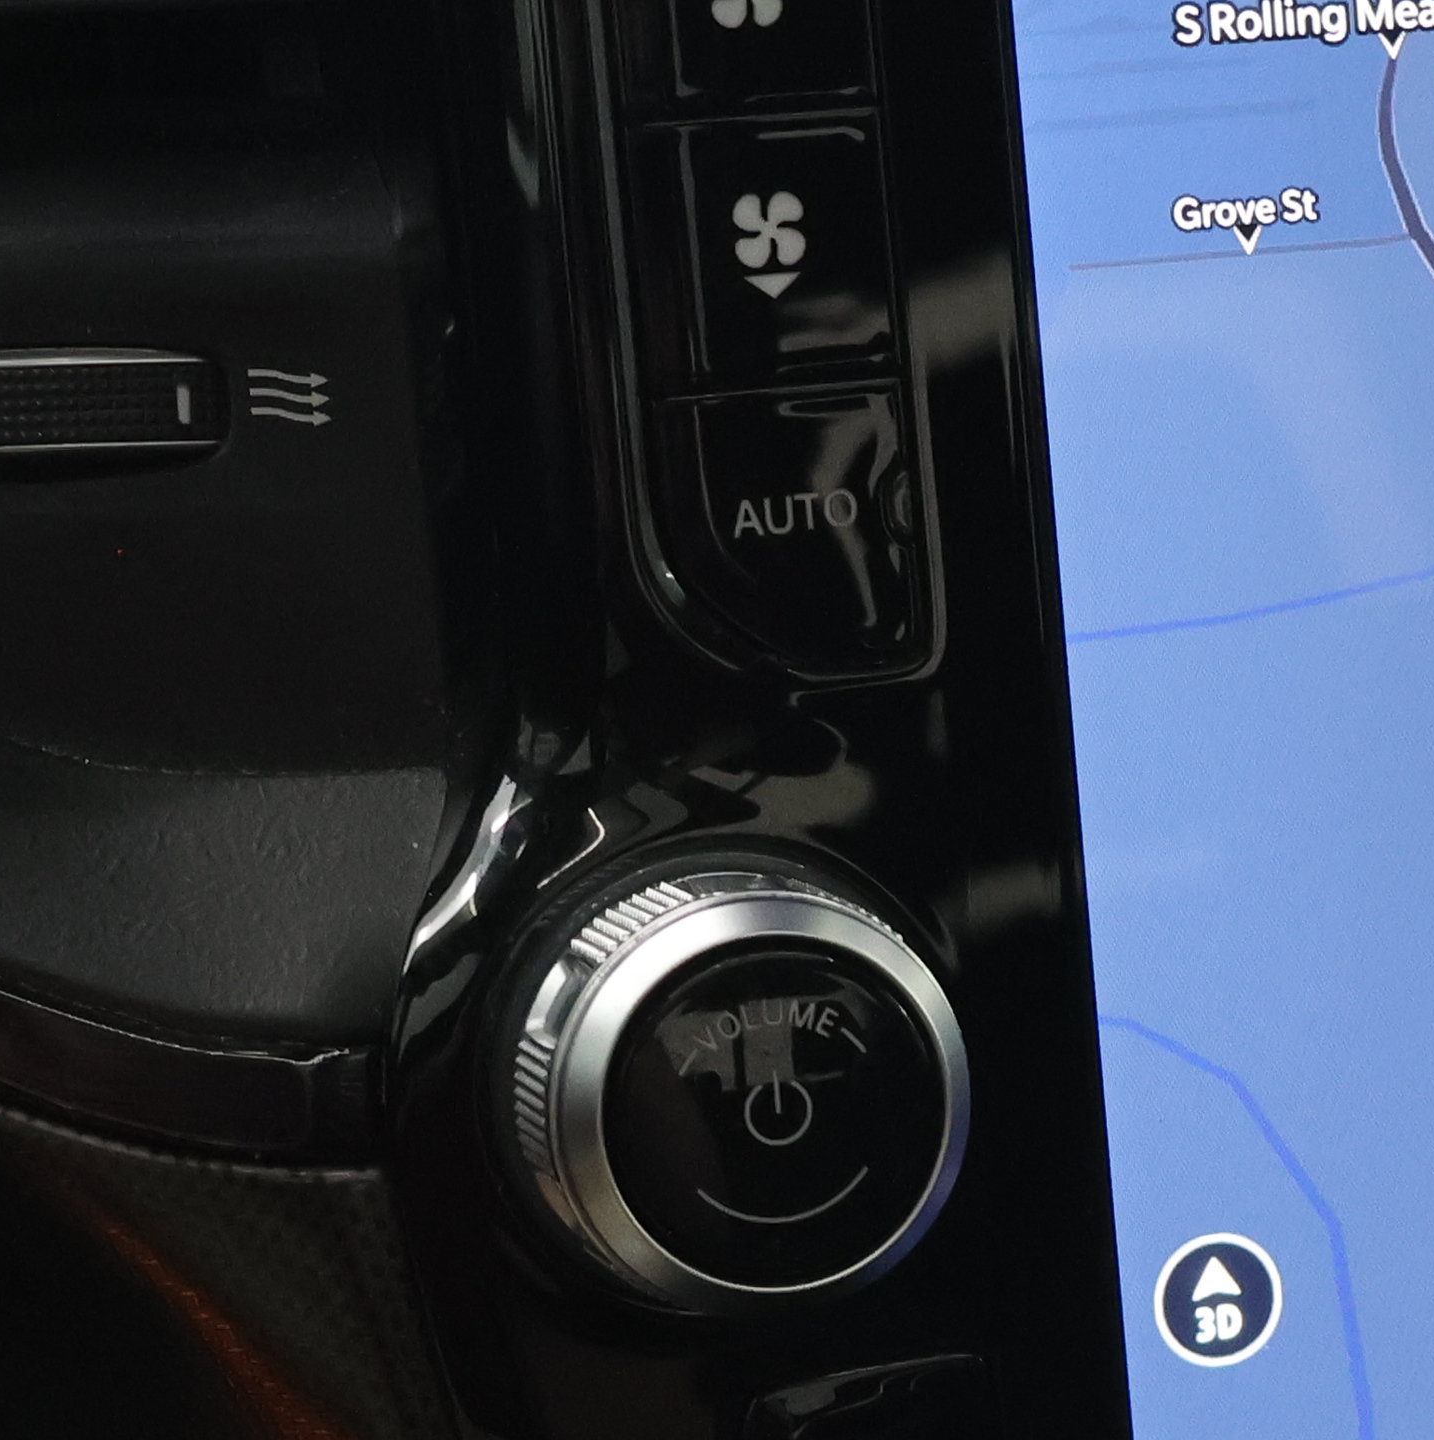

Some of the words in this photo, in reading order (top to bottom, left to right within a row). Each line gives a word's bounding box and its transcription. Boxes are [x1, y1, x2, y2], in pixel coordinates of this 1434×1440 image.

[1173, 1, 1206, 46] S
[1173, 195, 1276, 232] Grove
[1282, 188, 1319, 223] St
[734, 488, 858, 539] AUTO
[693, 998, 840, 1054] VOLUME
[1195, 1302, 1243, 1344] 3D
